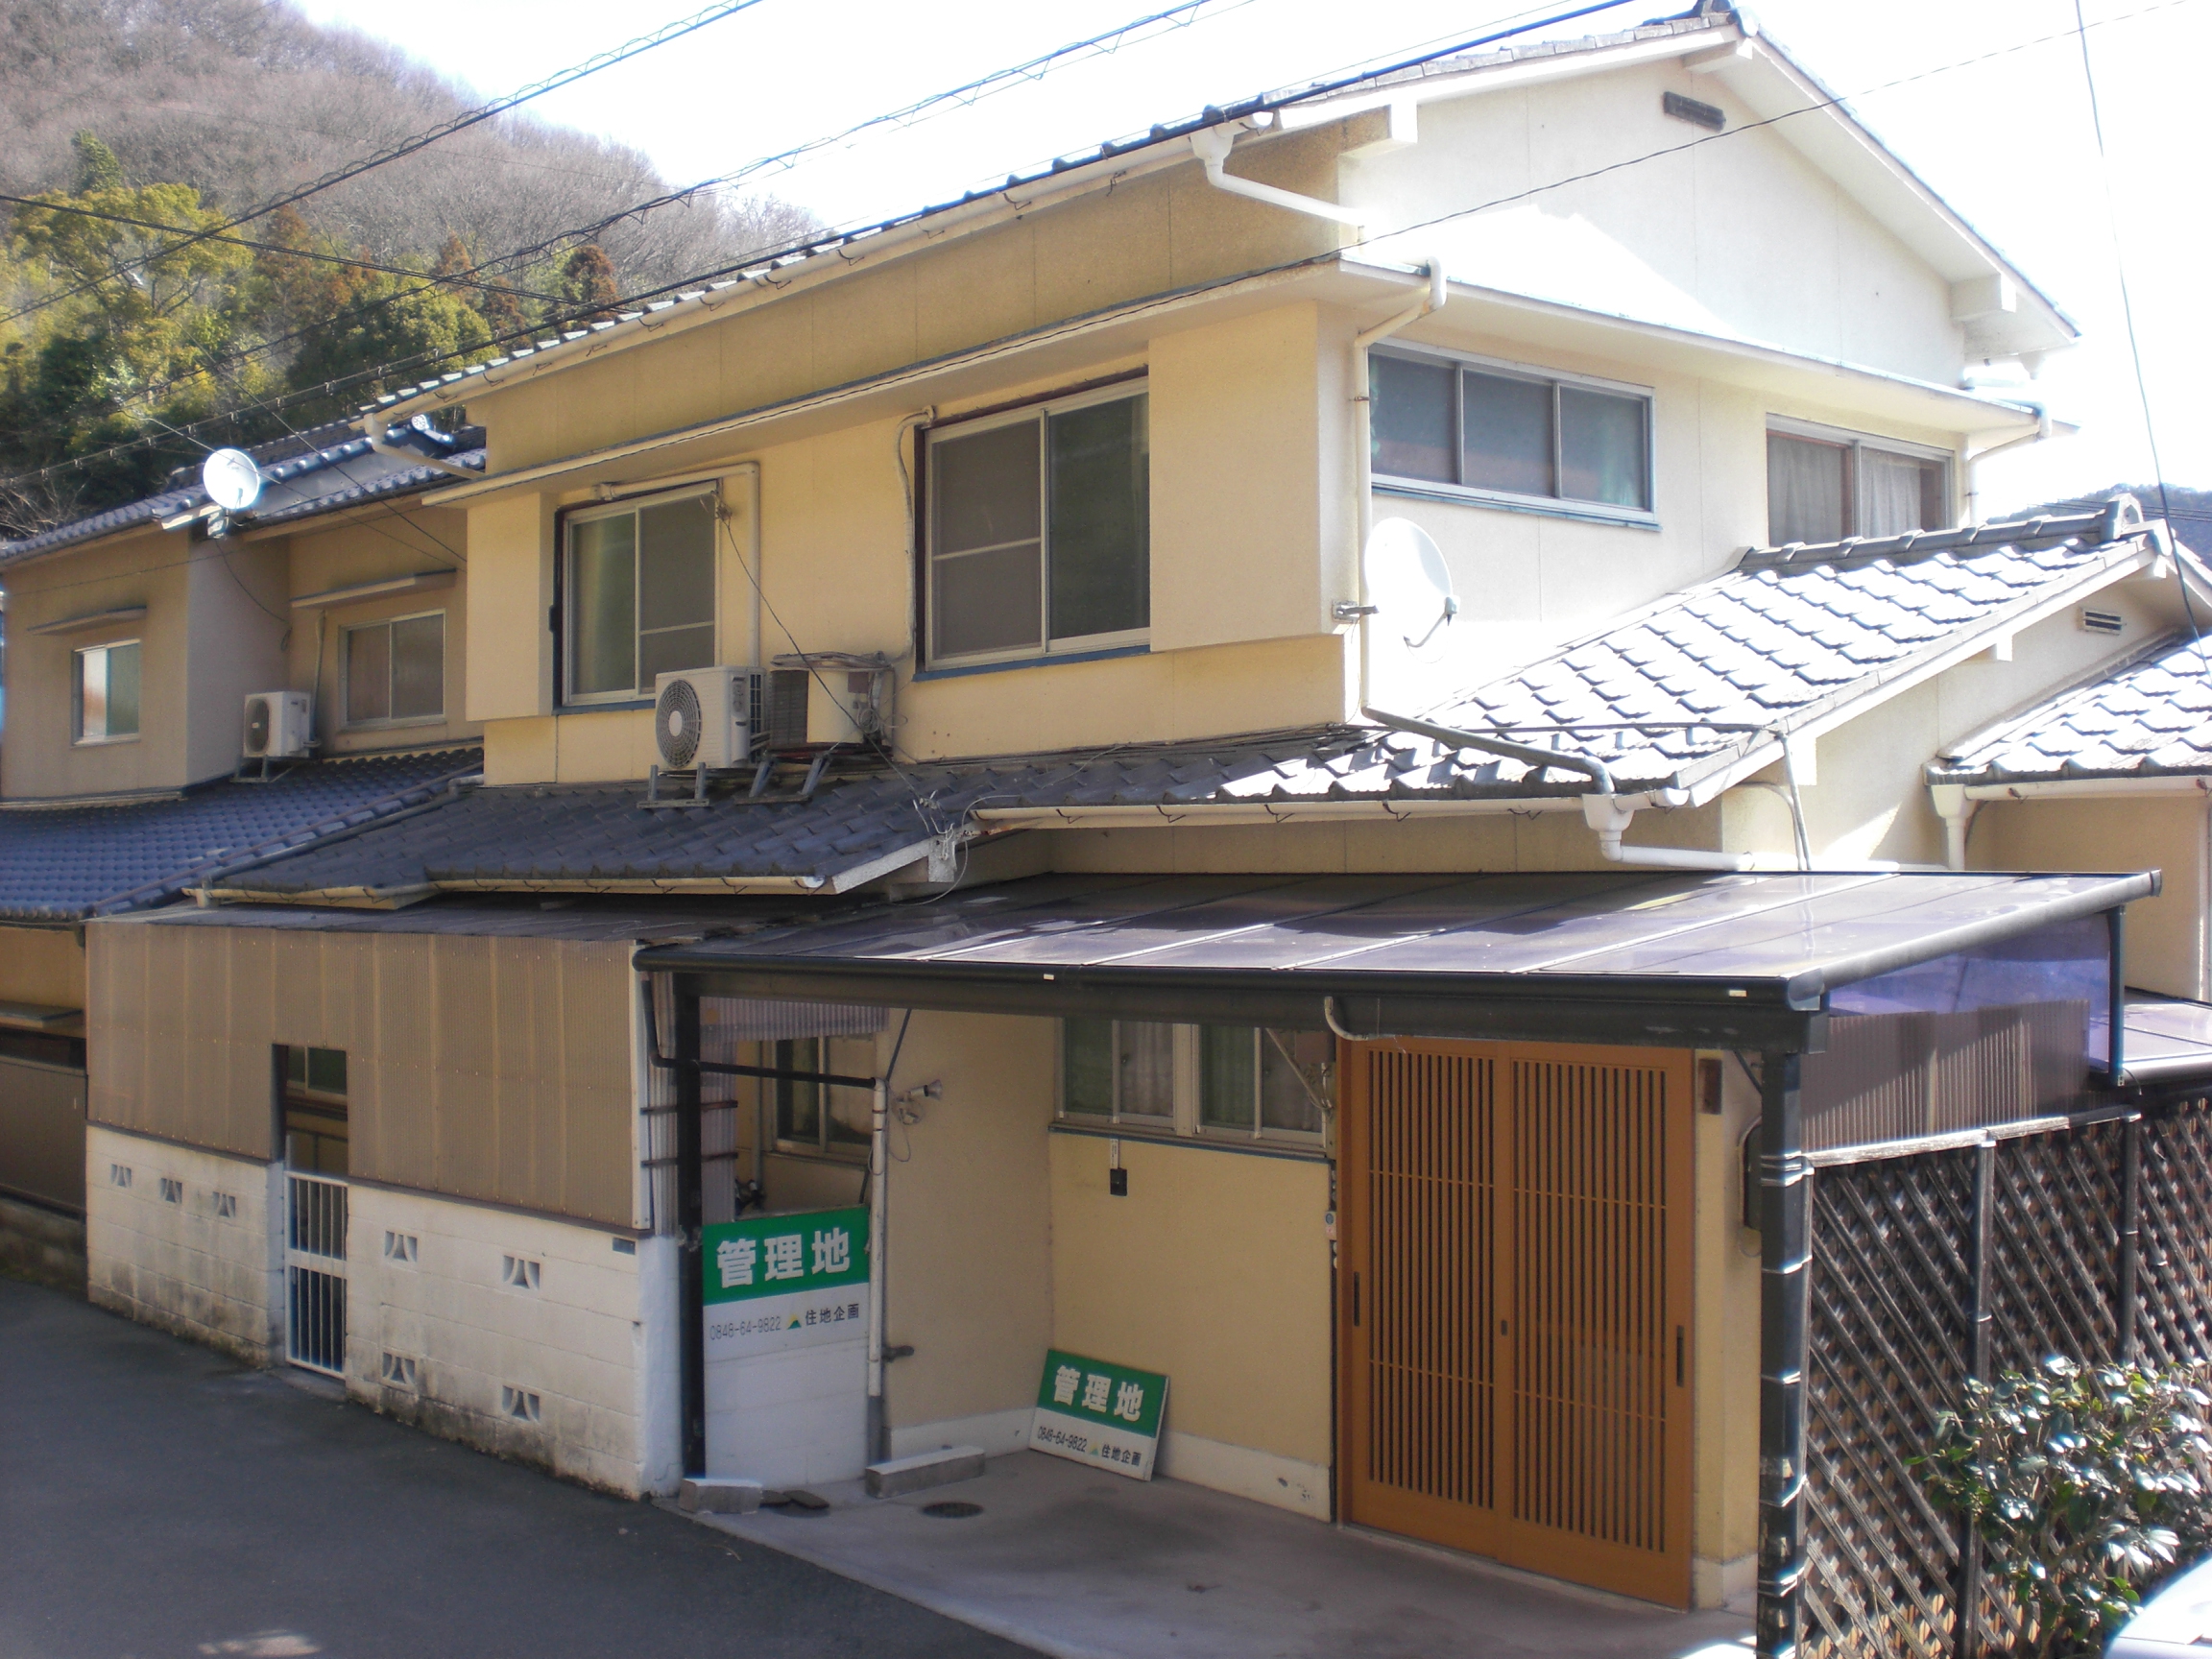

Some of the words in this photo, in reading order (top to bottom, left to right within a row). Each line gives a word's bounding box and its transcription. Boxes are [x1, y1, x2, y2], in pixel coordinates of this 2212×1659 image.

[716, 1227, 851, 1288] 管理地
[709, 1316, 781, 1340] 0848-64-9822
[805, 1303, 860, 1326] 住地企画
[1053, 1364, 1144, 1422] 管理地
[1101, 1444, 1142, 1467] 住地企画
